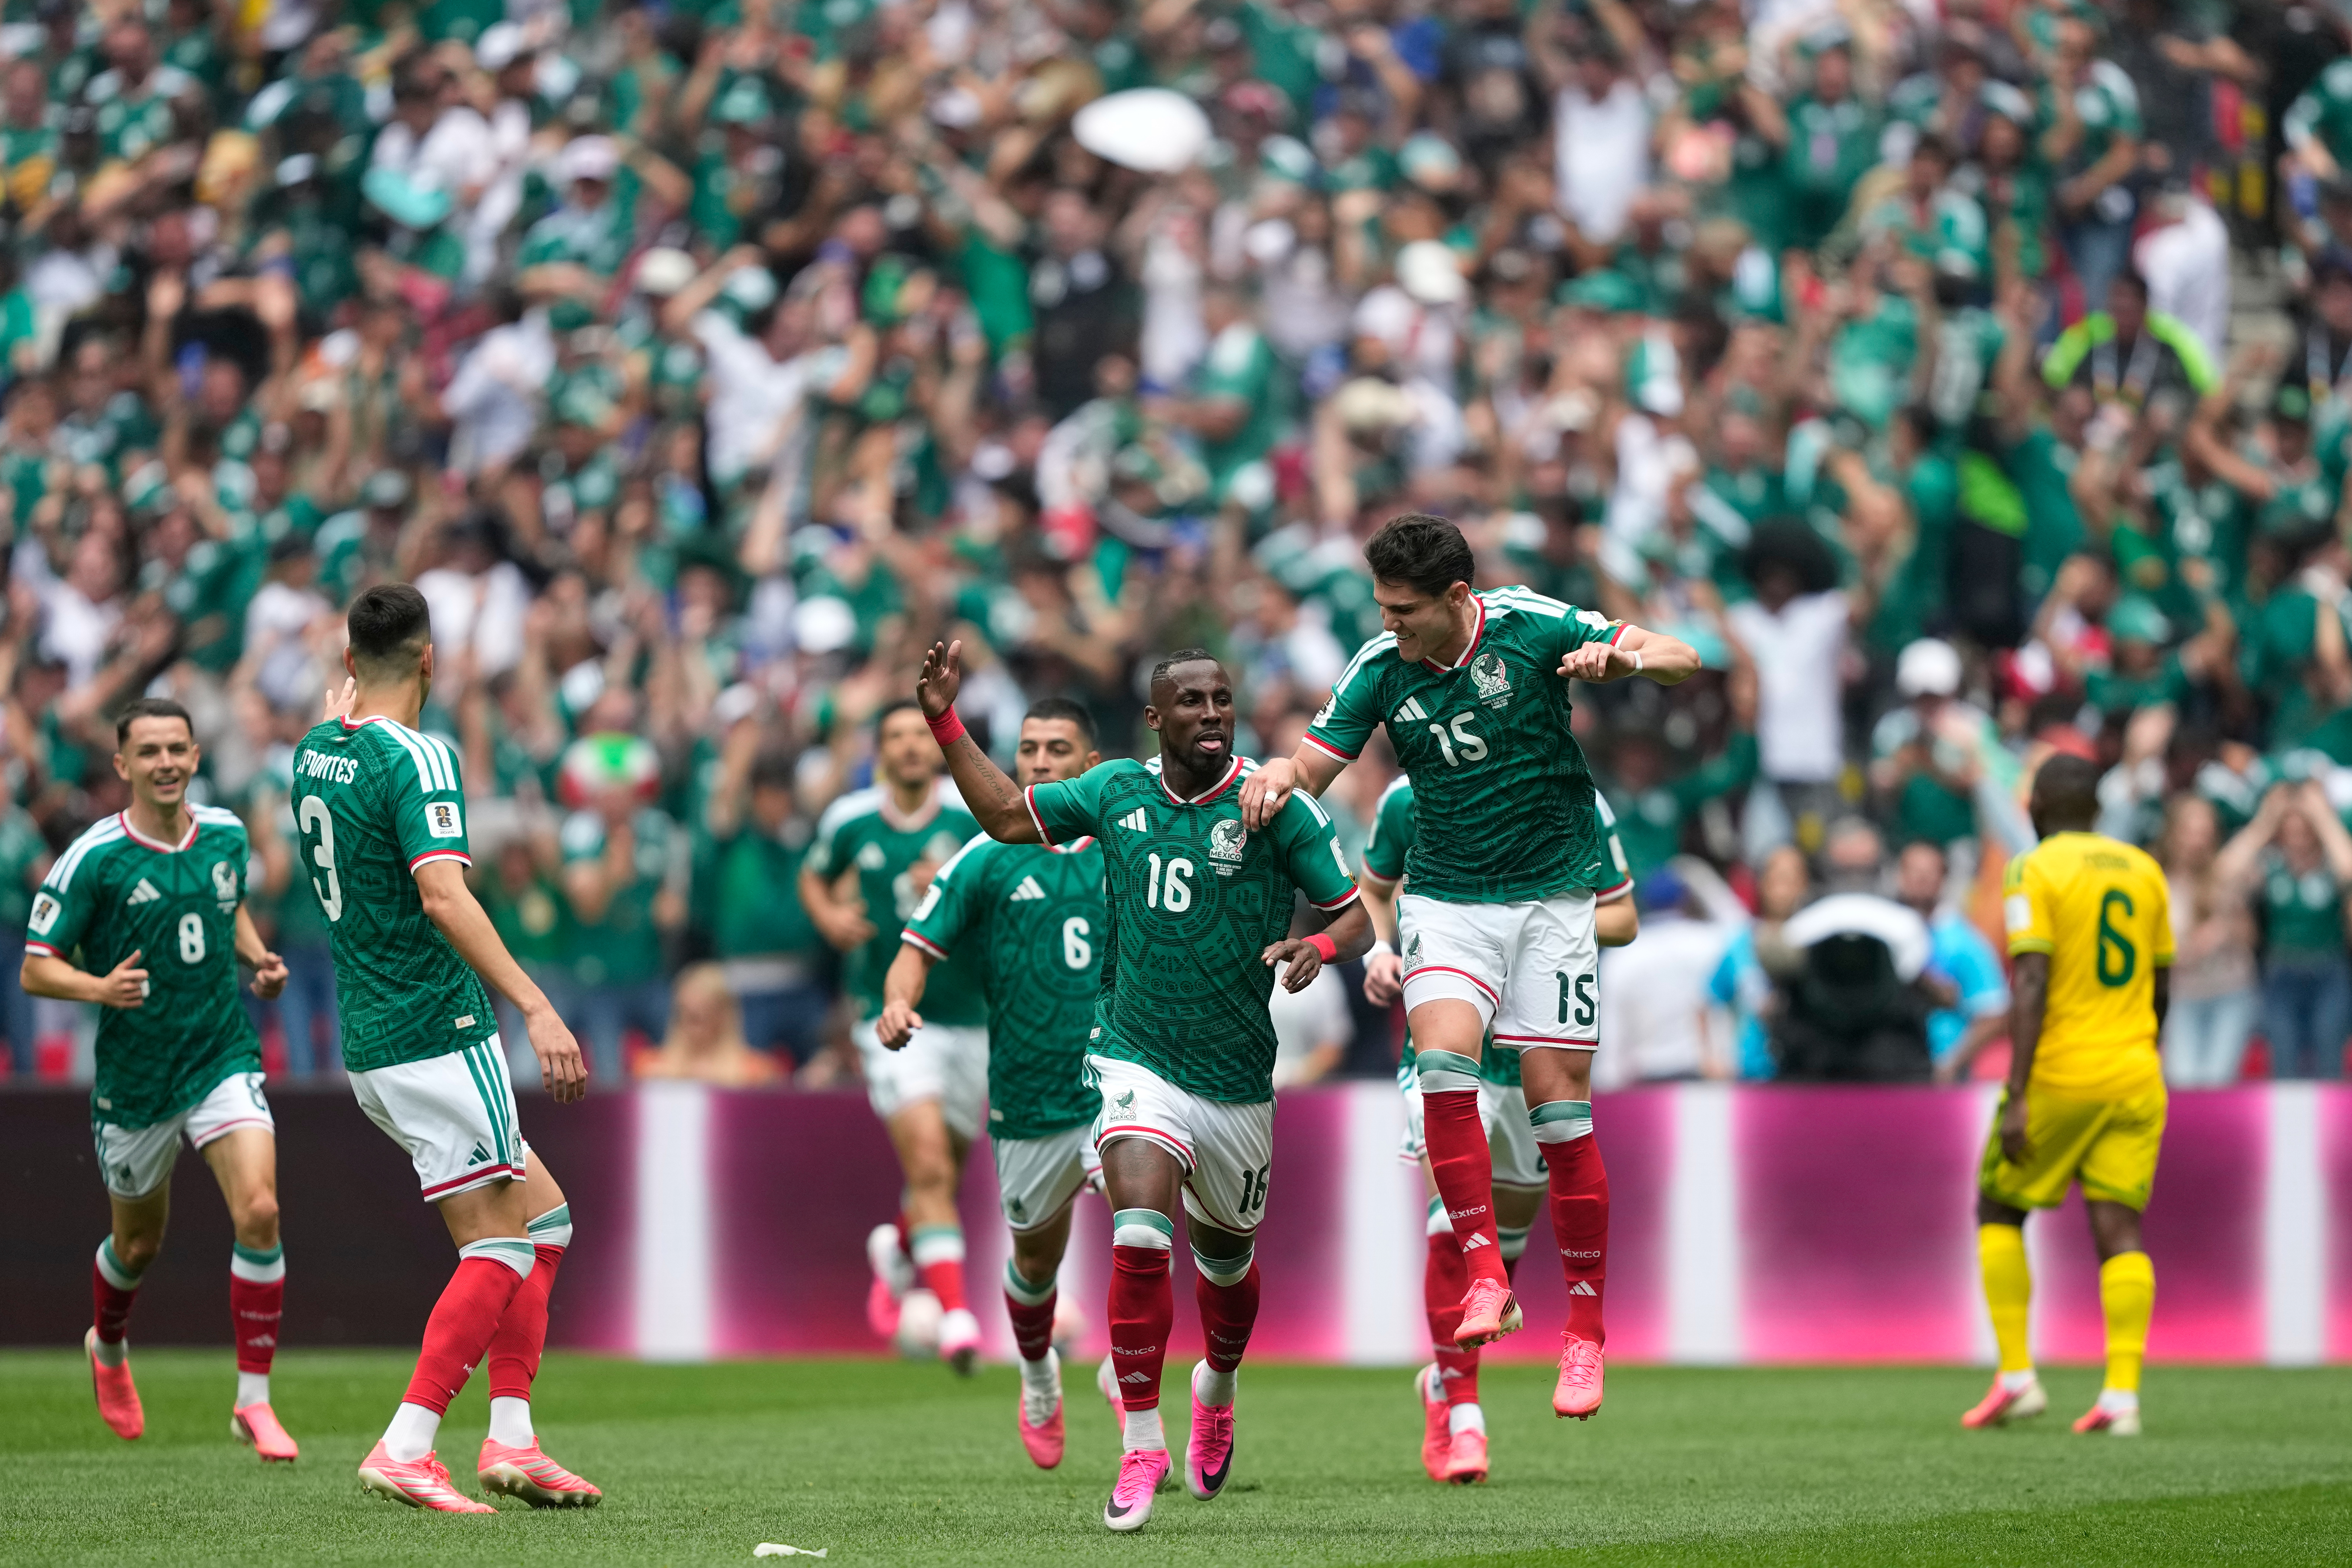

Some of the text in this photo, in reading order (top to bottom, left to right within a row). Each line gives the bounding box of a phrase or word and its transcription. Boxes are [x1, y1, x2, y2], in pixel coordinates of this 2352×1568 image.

[1480, 683, 1508, 697] MÉXICO
[1429, 711, 1488, 767] 15
[296, 748, 358, 784] MONTES
[299, 795, 342, 922] 3
[1210, 850, 1241, 860] MÉXICO
[1147, 853, 1194, 912] 16
[178, 913, 205, 964] 8
[1063, 917, 1092, 969] 6
[2097, 889, 2135, 988] 6
[1556, 971, 1595, 1026] 15
[1239, 1162, 1269, 1213] 16
[1449, 1205, 1487, 1220] MÉXICO
[1561, 1248, 1601, 1258] MÉXICO
[1111, 1343, 1155, 1355] MÉXICO
